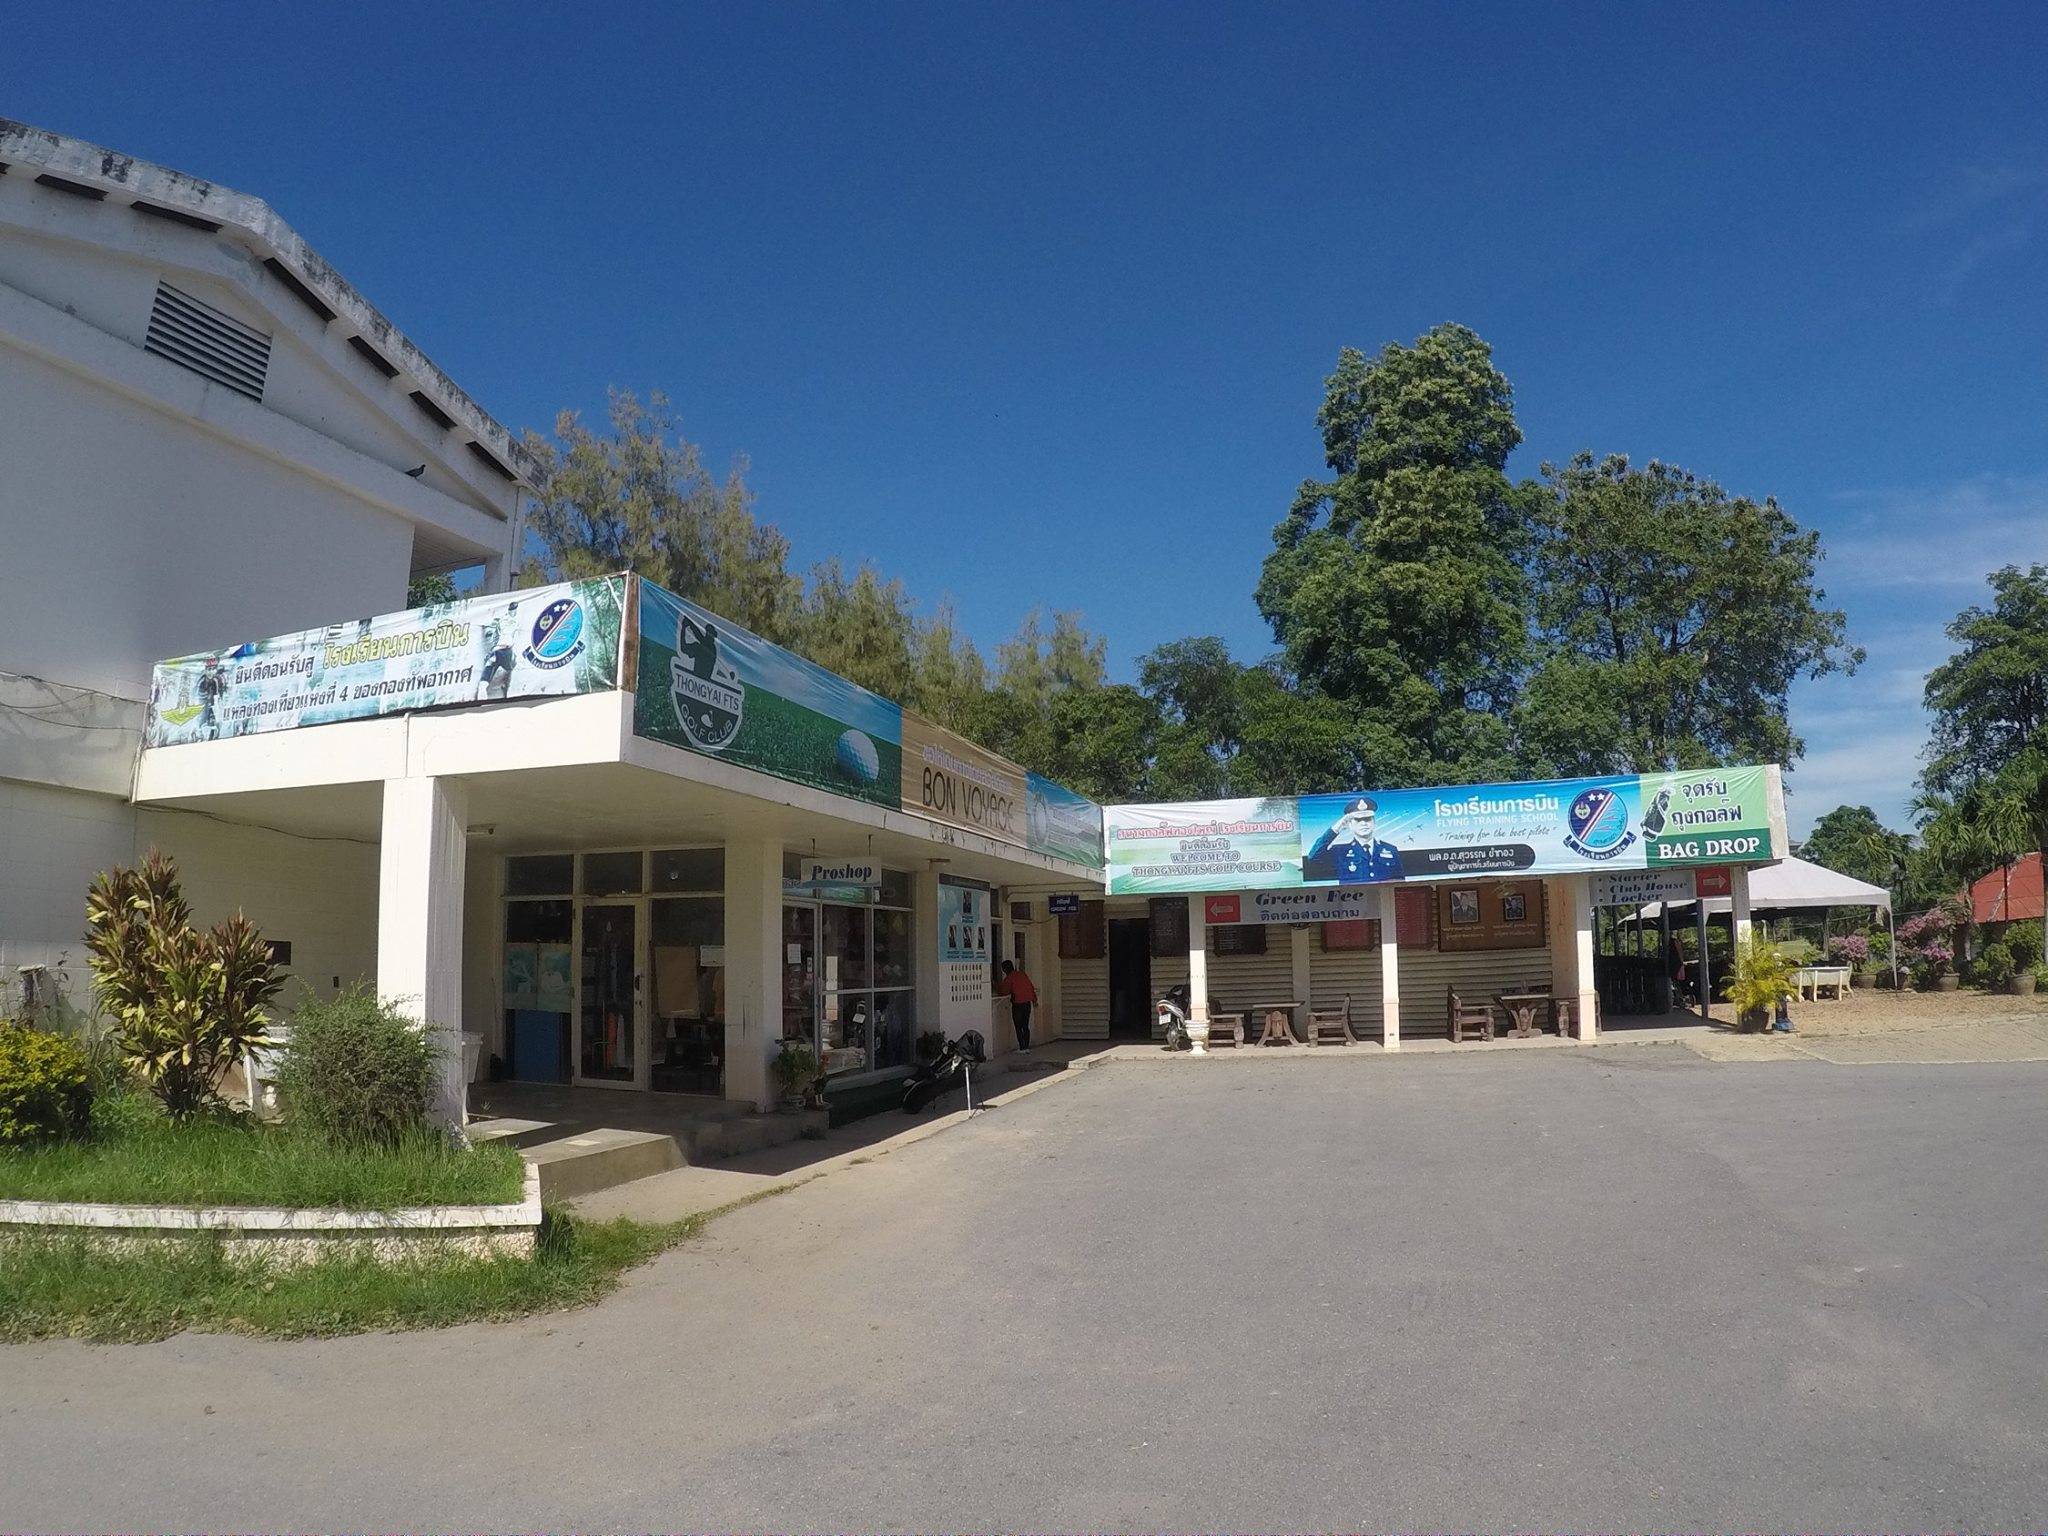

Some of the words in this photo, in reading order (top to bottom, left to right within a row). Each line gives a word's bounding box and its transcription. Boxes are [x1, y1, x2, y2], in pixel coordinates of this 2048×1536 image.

[235, 645, 317, 684] ยินดีต้อนรับสู่
[322, 619, 471, 669] โรงเรียนการบิน
[222, 681, 337, 722] แหล่งท่องเที่ยวแห่งที่
[339, 685, 349, 702] 4
[353, 665, 473, 700] ของกองทัพอากาศ
[676, 673, 721, 704] THONGYAI
[723, 693, 740, 711] FTS
[681, 703, 706, 738] GOLF
[707, 719, 733, 743] CLUB
[1681, 777, 1728, 803] จุดรับ
[922, 766, 957, 817] BON
[961, 781, 1014, 834] VOYAGE
[1434, 794, 1559, 817] โรงเรียนการบิน
[1436, 817, 1470, 828] FLYING
[1472, 814, 1518, 825] TRAINING
[1520, 811, 1559, 823] SCHOOL
[1671, 798, 1743, 832] ถุงกอล์ฟ
[1218, 818, 1293, 835] โรงเรียนการบิน
[1477, 828, 1490, 843] for
[1494, 827, 1506, 837] the
[1510, 826, 1527, 837] best
[1179, 837, 1230, 851] ยินดีต้อนรับ
[1658, 841, 1701, 859] BAG
[1705, 837, 1761, 856] DROP
[1171, 852, 1224, 864] WELCOME
[1225, 851, 1241, 862] TO
[811, 863, 873, 882] Proshop
[1208, 863, 1236, 874] GOLF
[1237, 861, 1282, 873] COURSE
[1608, 873, 1661, 883] Starter
[1609, 884, 1642, 894] Club
[1645, 882, 1688, 891] House
[1255, 892, 1317, 906] Green
[1327, 889, 1365, 903] Fee
[1612, 893, 1663, 904] Locker
[1260, 907, 1360, 922] ติดต่อสอบถาม
